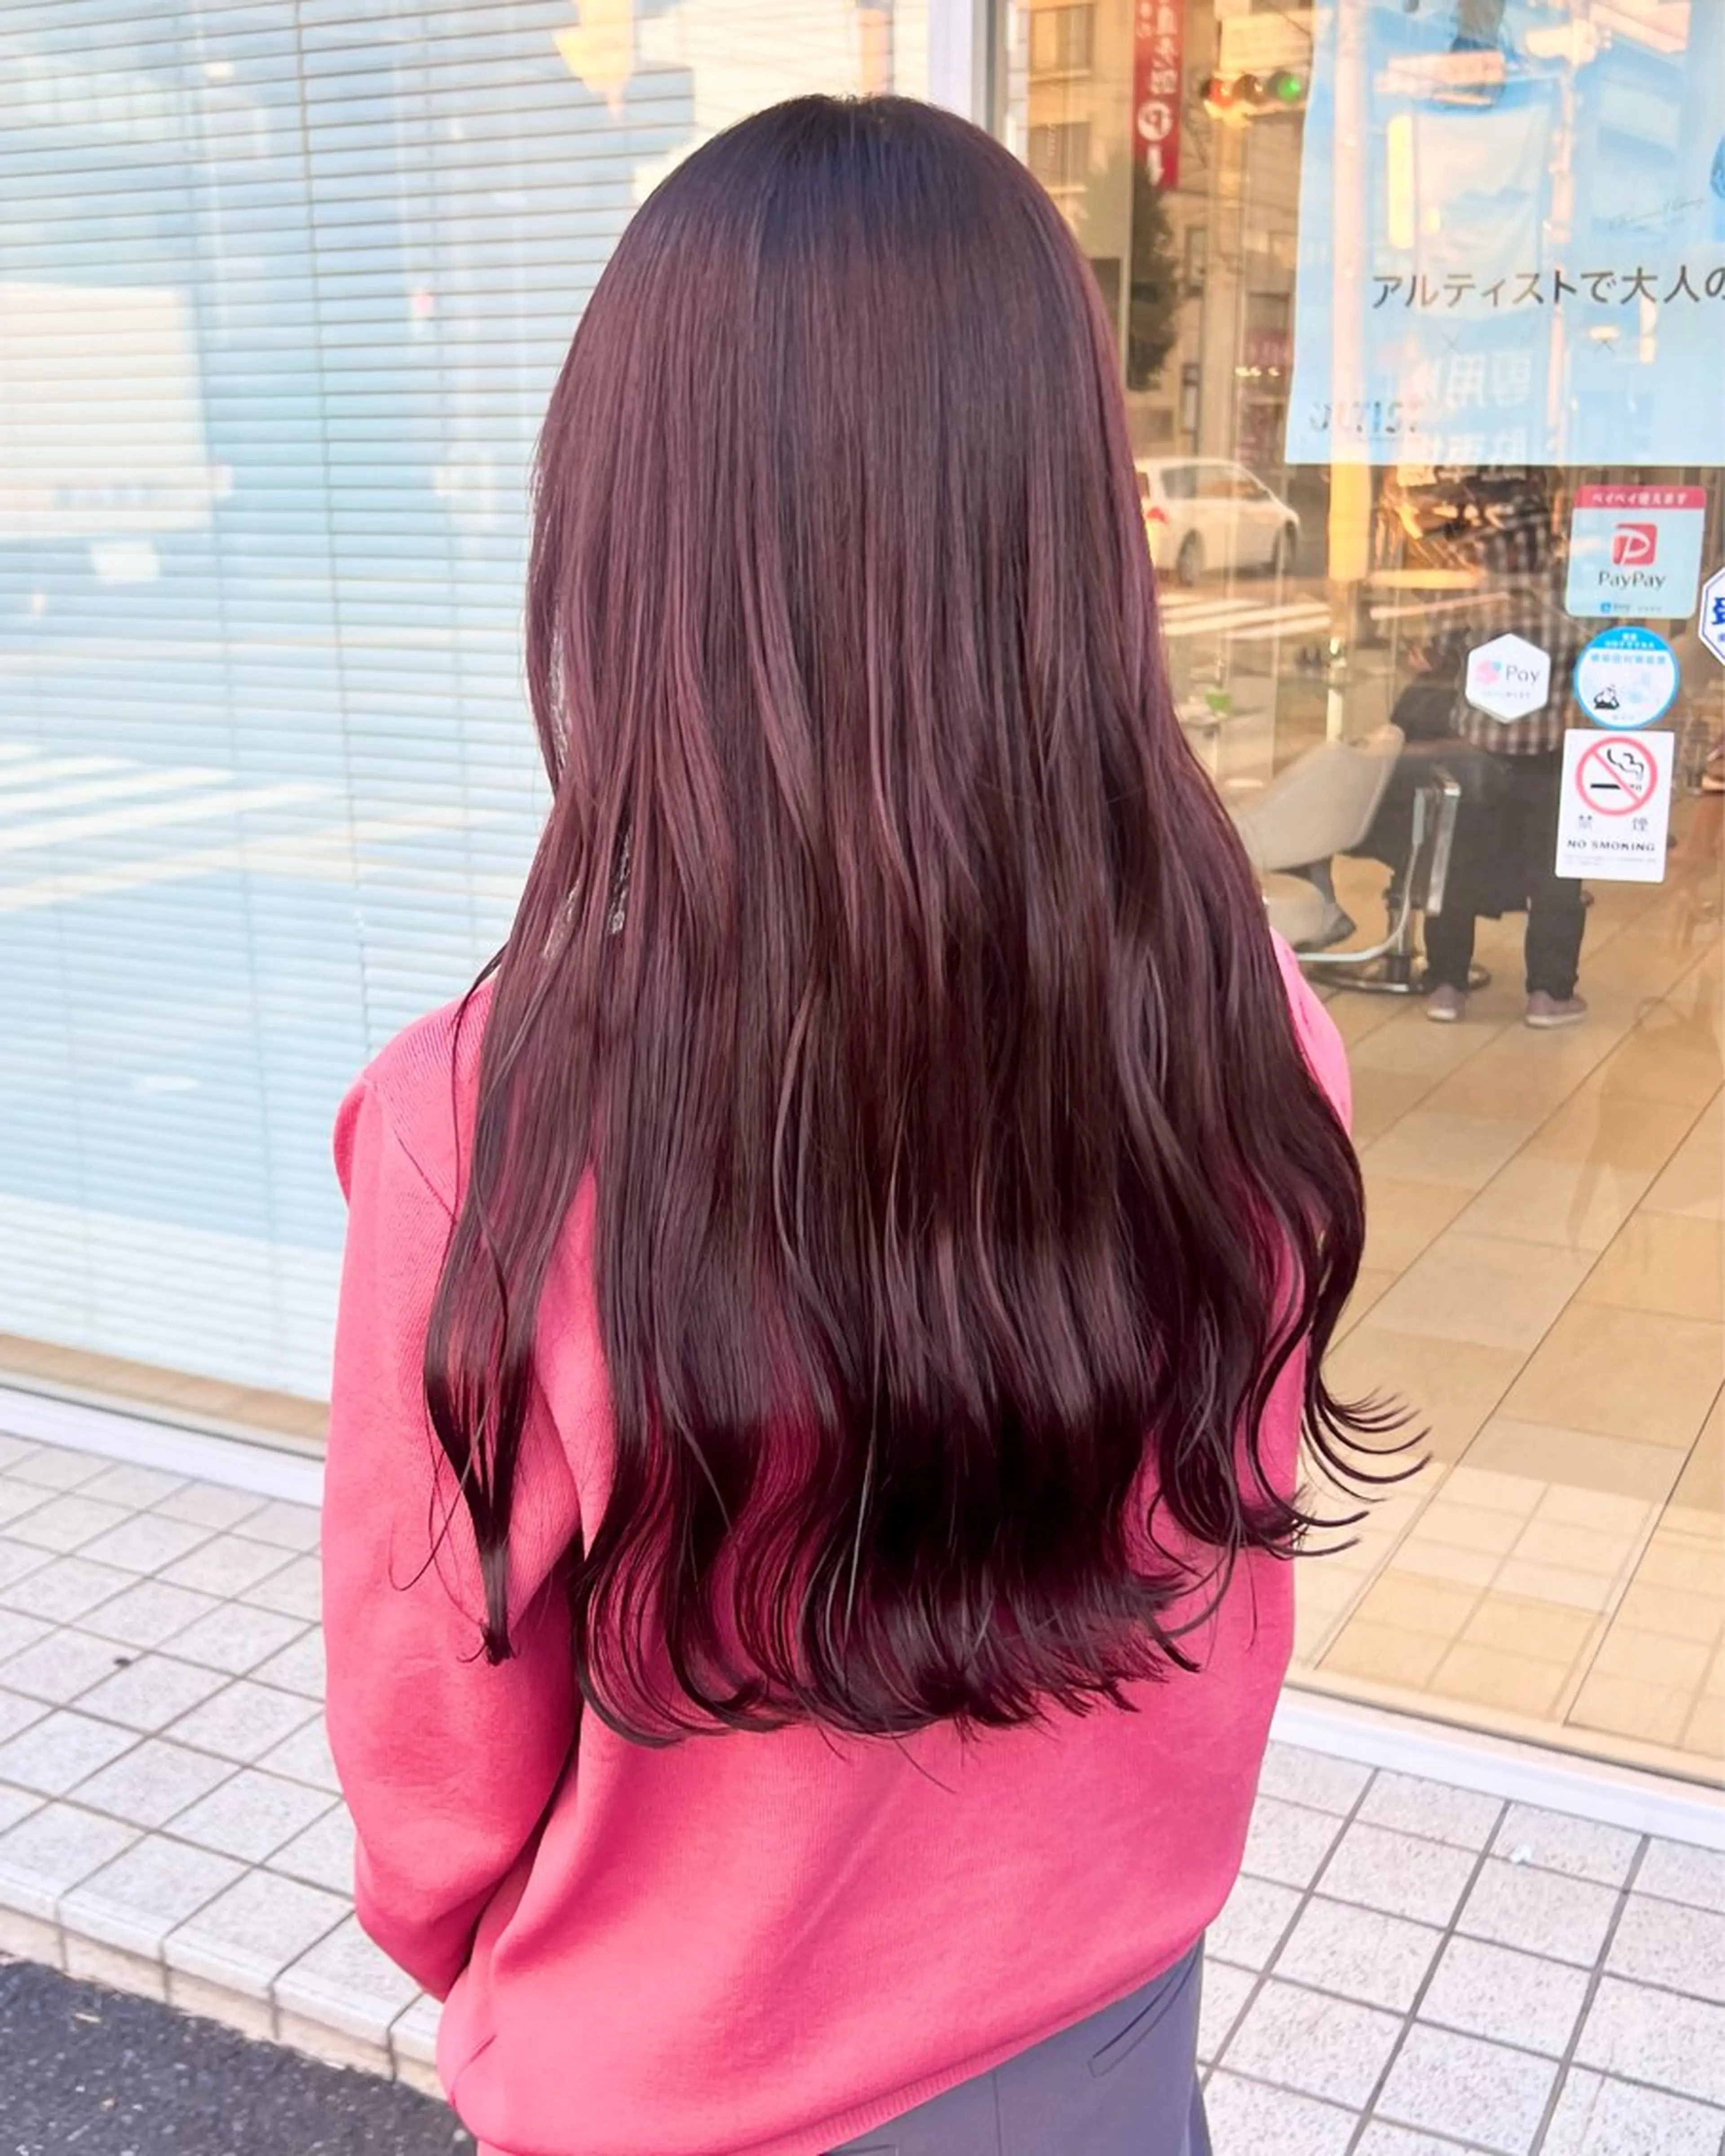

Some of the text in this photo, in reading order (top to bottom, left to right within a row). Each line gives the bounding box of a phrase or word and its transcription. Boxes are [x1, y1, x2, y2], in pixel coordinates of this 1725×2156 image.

[1598, 570, 1666, 590] PayPay
[1506, 664, 1539, 684] Pay
[1566, 839, 1655, 852] NO SMOKING
